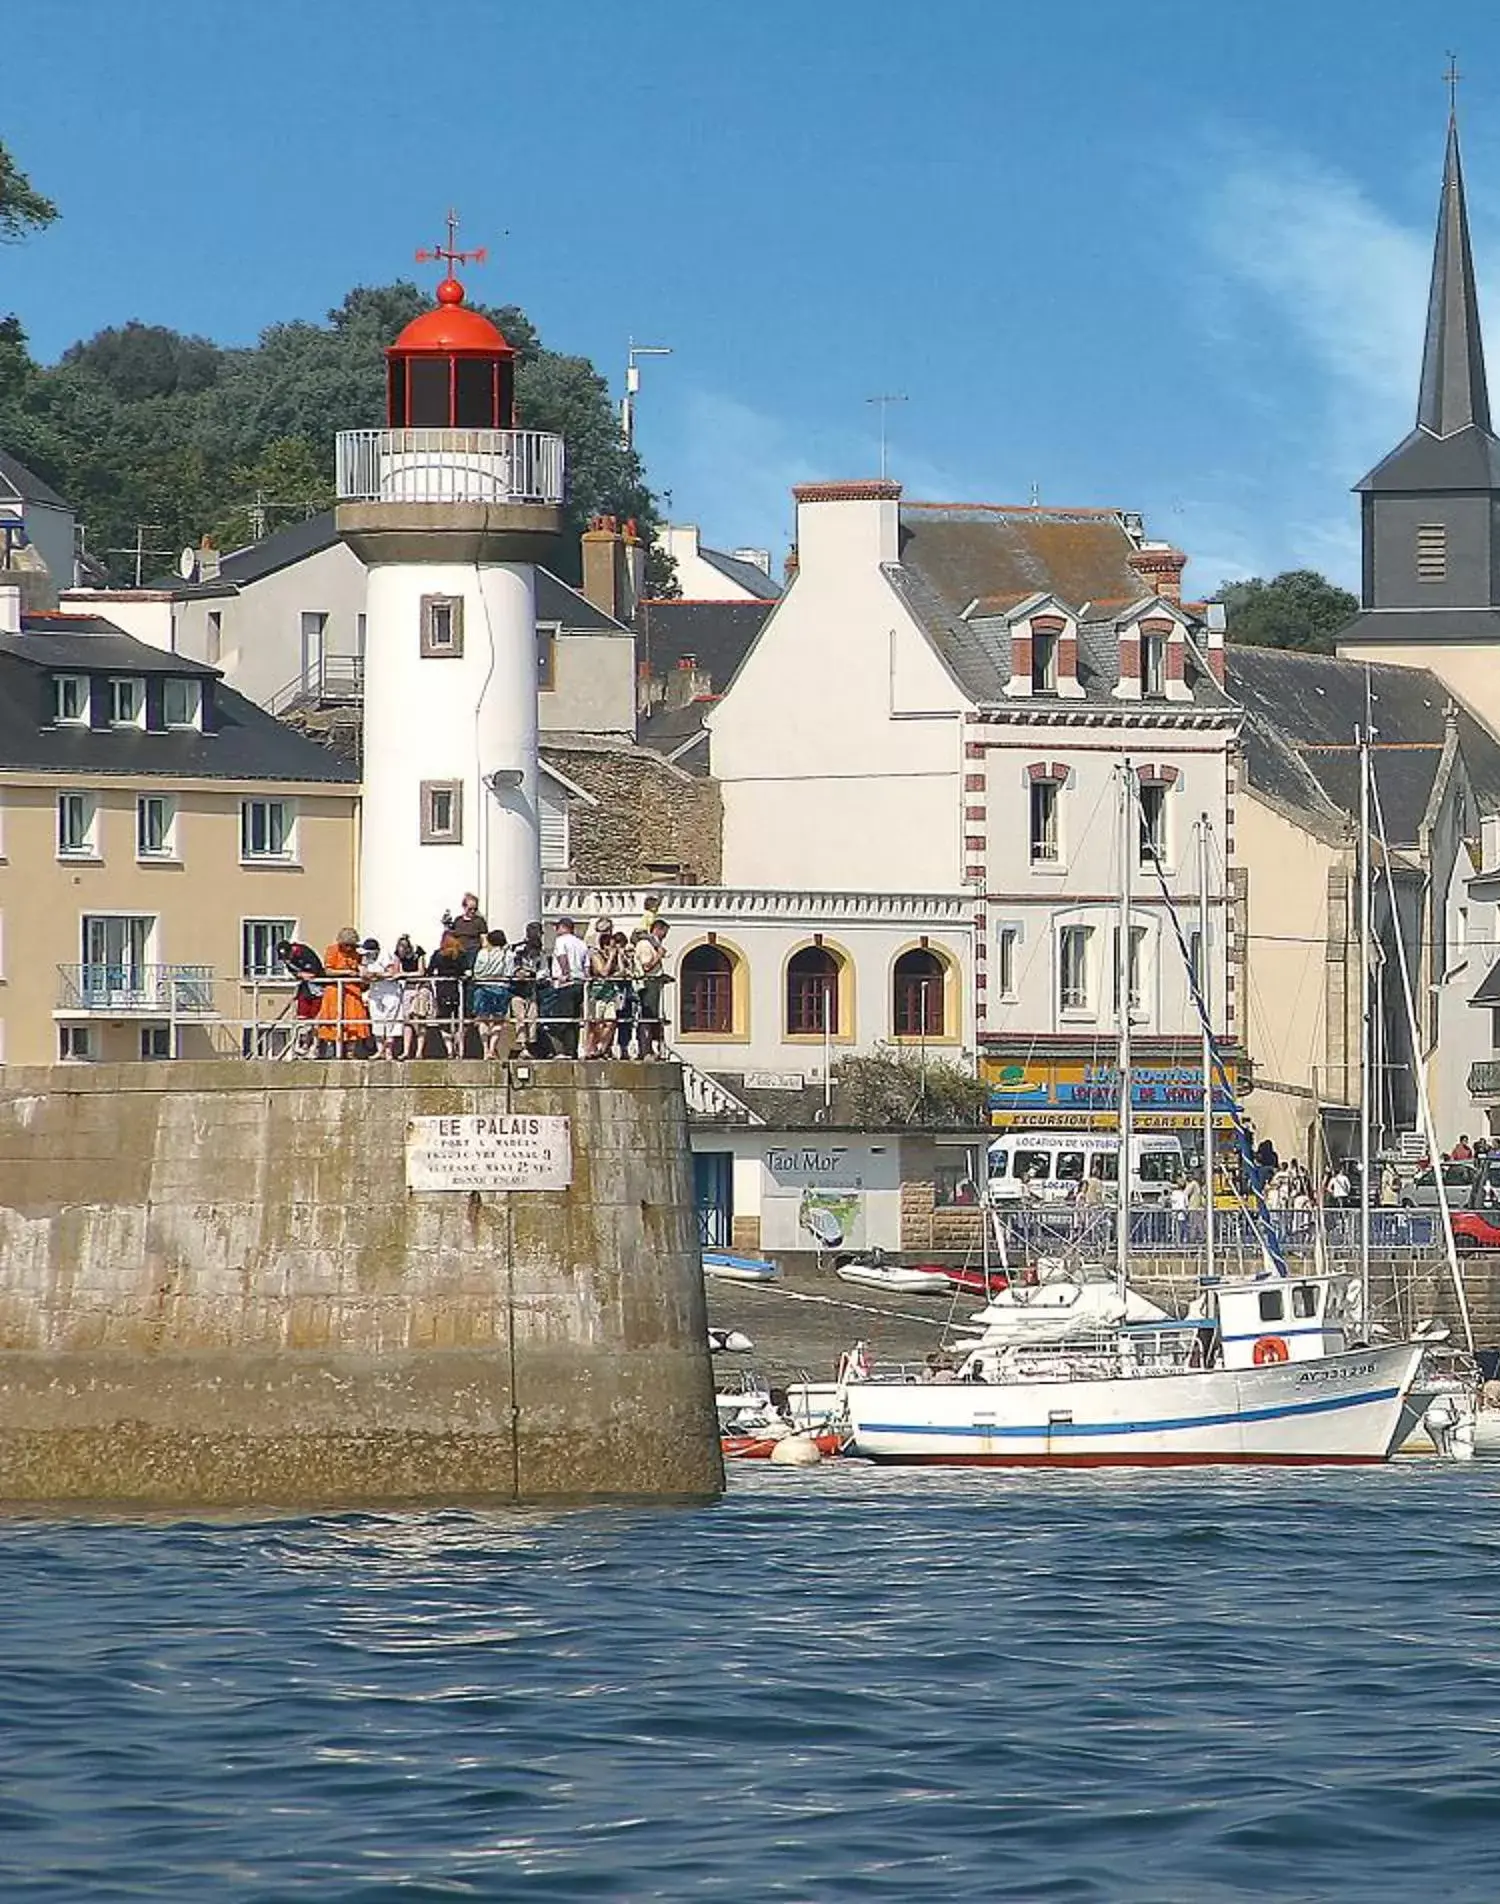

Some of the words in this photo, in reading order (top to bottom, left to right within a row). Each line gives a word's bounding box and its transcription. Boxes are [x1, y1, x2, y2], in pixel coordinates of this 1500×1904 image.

[439, 1119, 461, 1136] LE
[476, 1119, 540, 1136] PALAIS
[1012, 1115, 1095, 1126] EXCURSIONS
[1144, 1117, 1177, 1127] CARS
[803, 1153, 842, 1171] Mor
